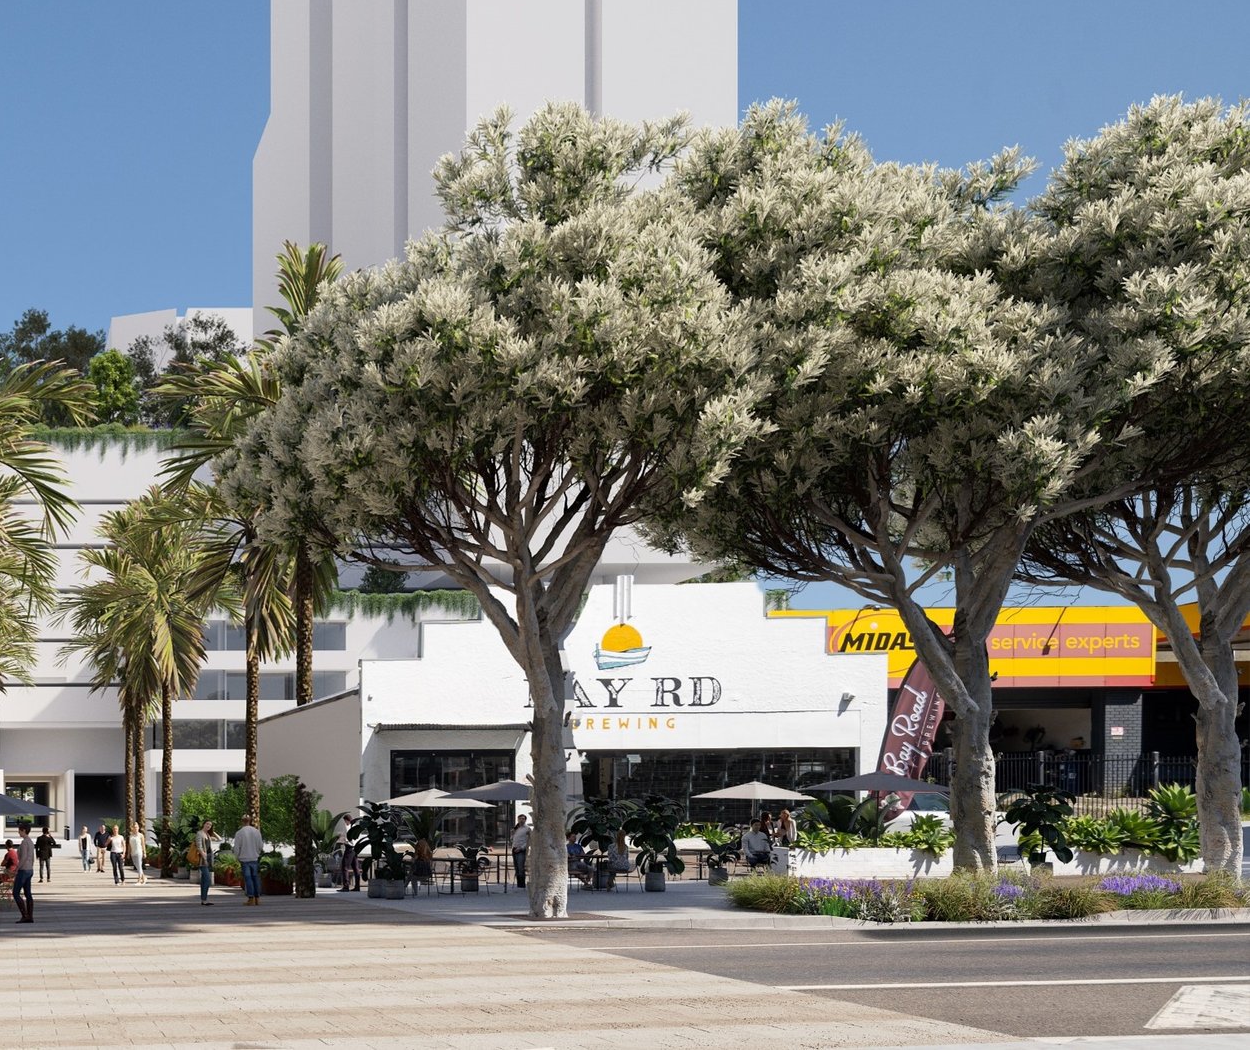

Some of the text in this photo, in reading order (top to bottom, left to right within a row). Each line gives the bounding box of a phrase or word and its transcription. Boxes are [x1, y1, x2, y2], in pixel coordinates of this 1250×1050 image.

[991, 633, 1140, 654] service experts
[523, 676, 722, 708] AY RD
[883, 684, 929, 776] Bay Road
